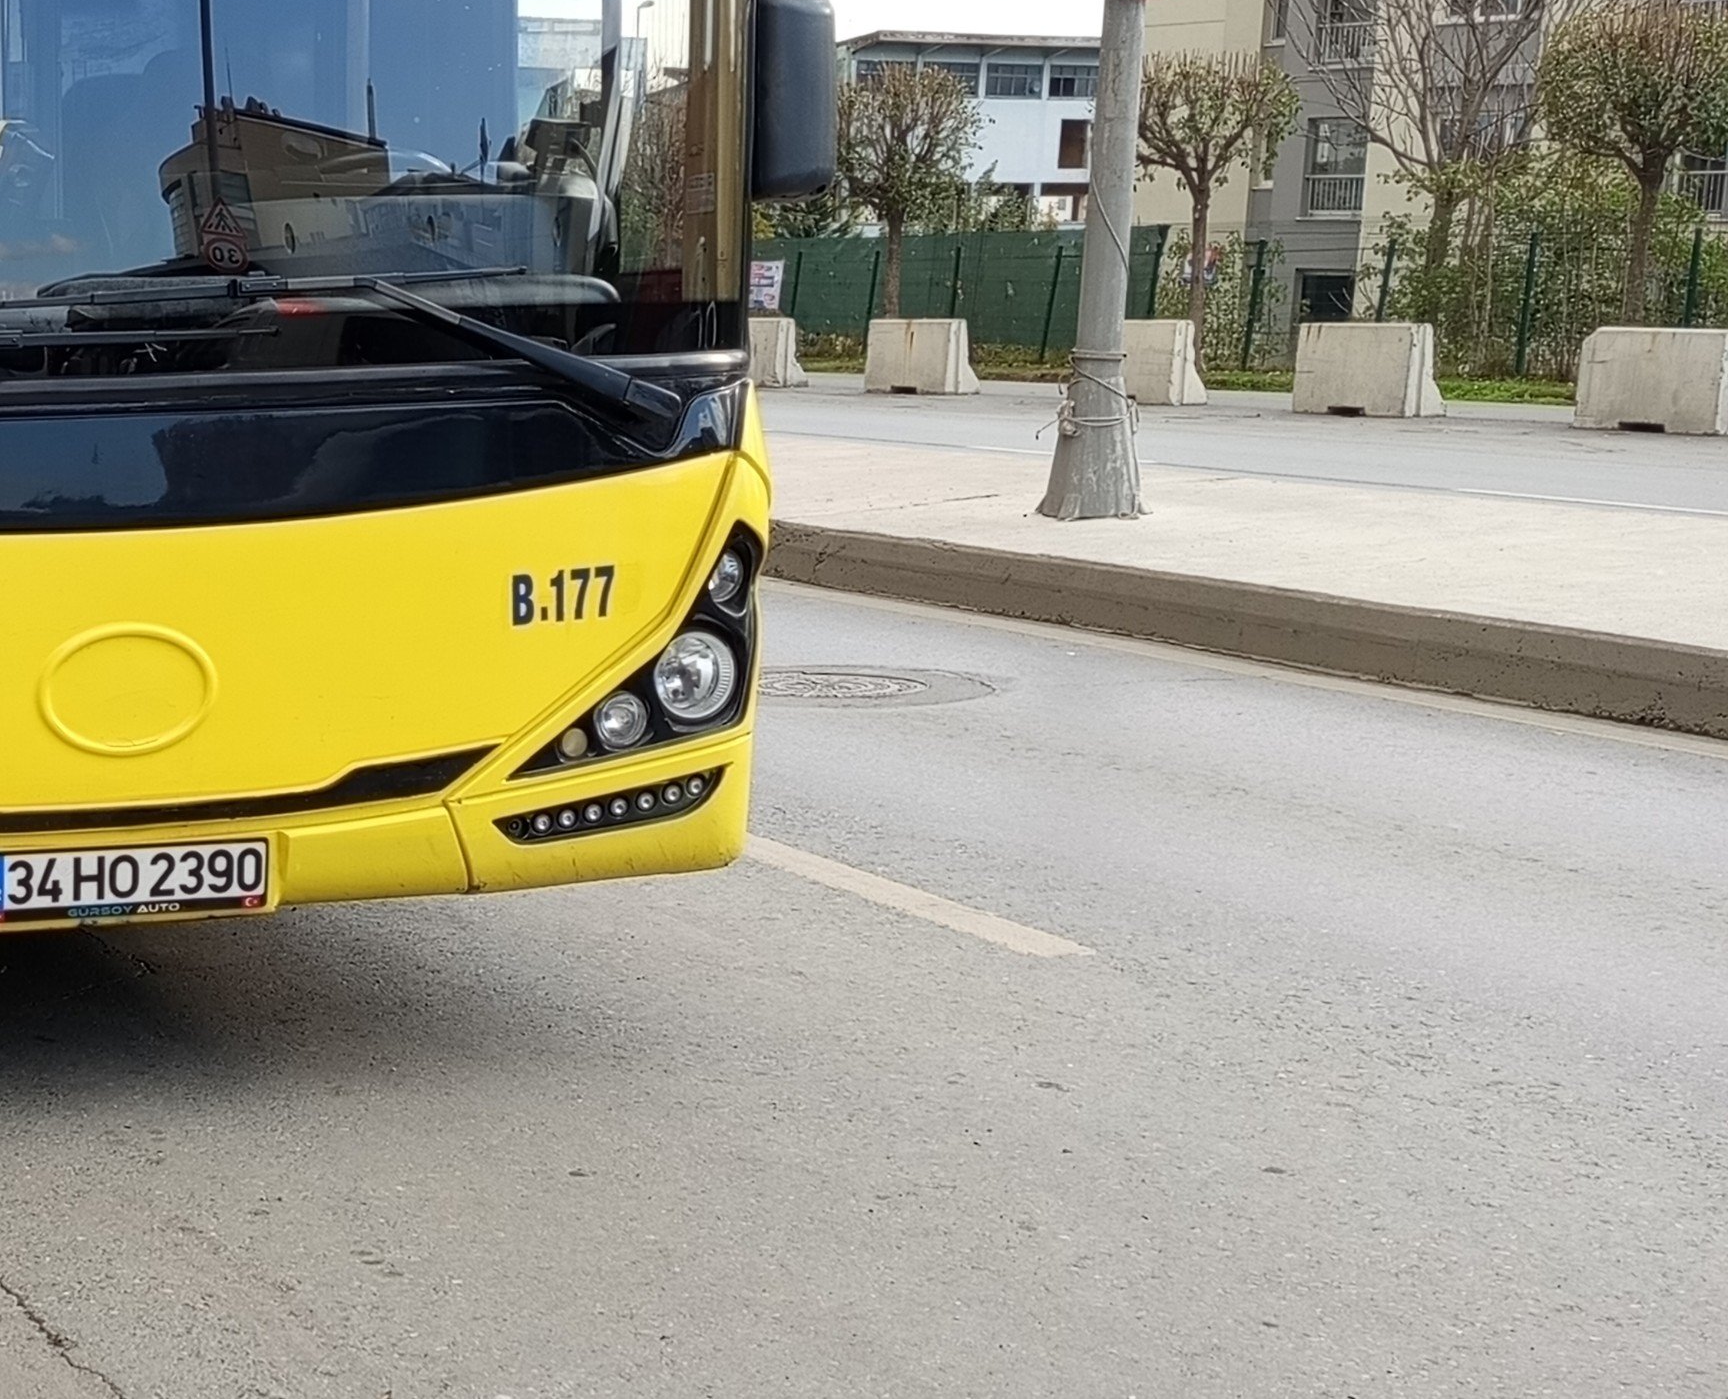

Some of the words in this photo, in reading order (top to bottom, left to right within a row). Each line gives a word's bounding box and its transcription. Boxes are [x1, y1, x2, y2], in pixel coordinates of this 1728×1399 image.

[512, 564, 615, 626] B.177
[7, 858, 63, 905] 34
[73, 854, 140, 901] HO
[149, 847, 263, 897] 2390
[136, 902, 180, 914] AUTO
